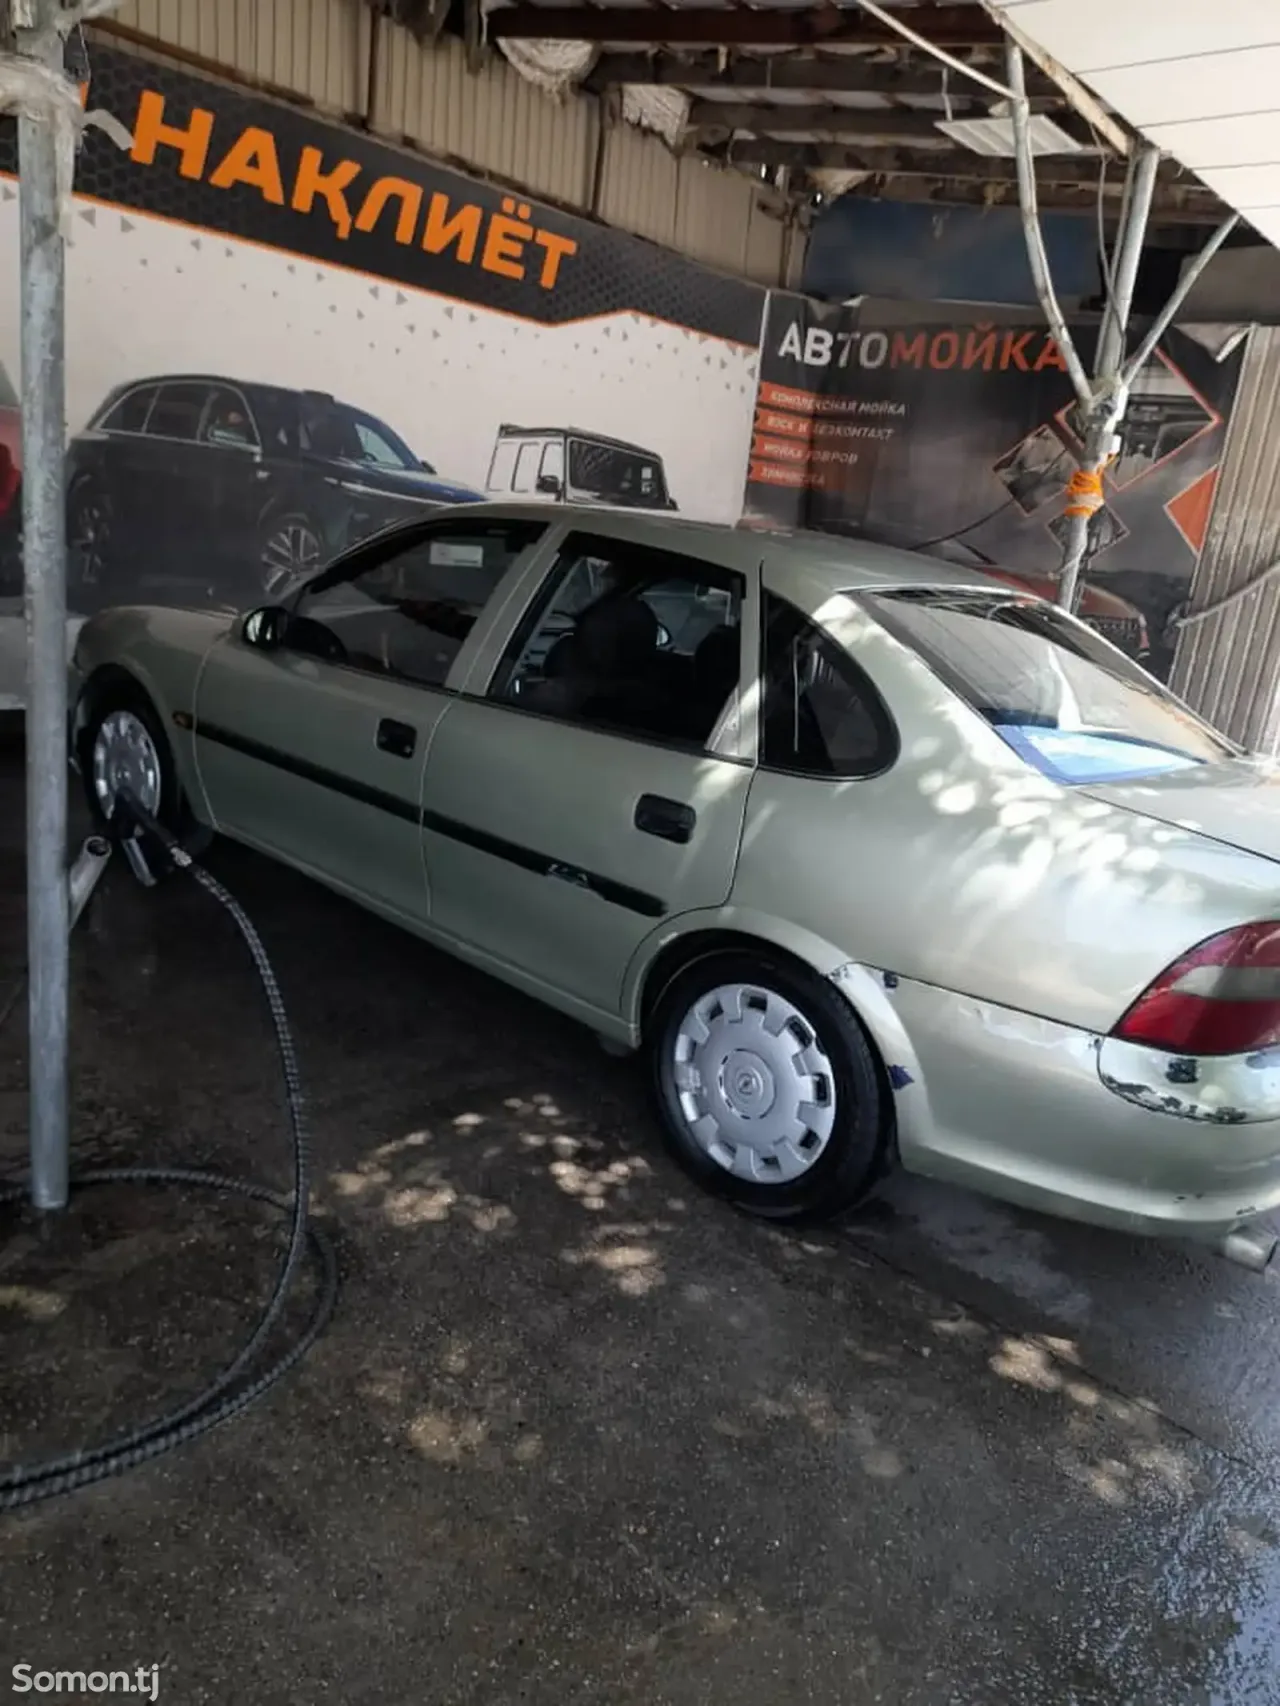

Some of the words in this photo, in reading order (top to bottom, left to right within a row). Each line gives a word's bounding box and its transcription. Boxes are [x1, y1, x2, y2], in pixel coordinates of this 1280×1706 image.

[130, 89, 577, 289] НАҚЛИЁТ
[777, 320, 1067, 372] АВТОМОЙКА
[858, 400, 906, 417] МОЙКА
